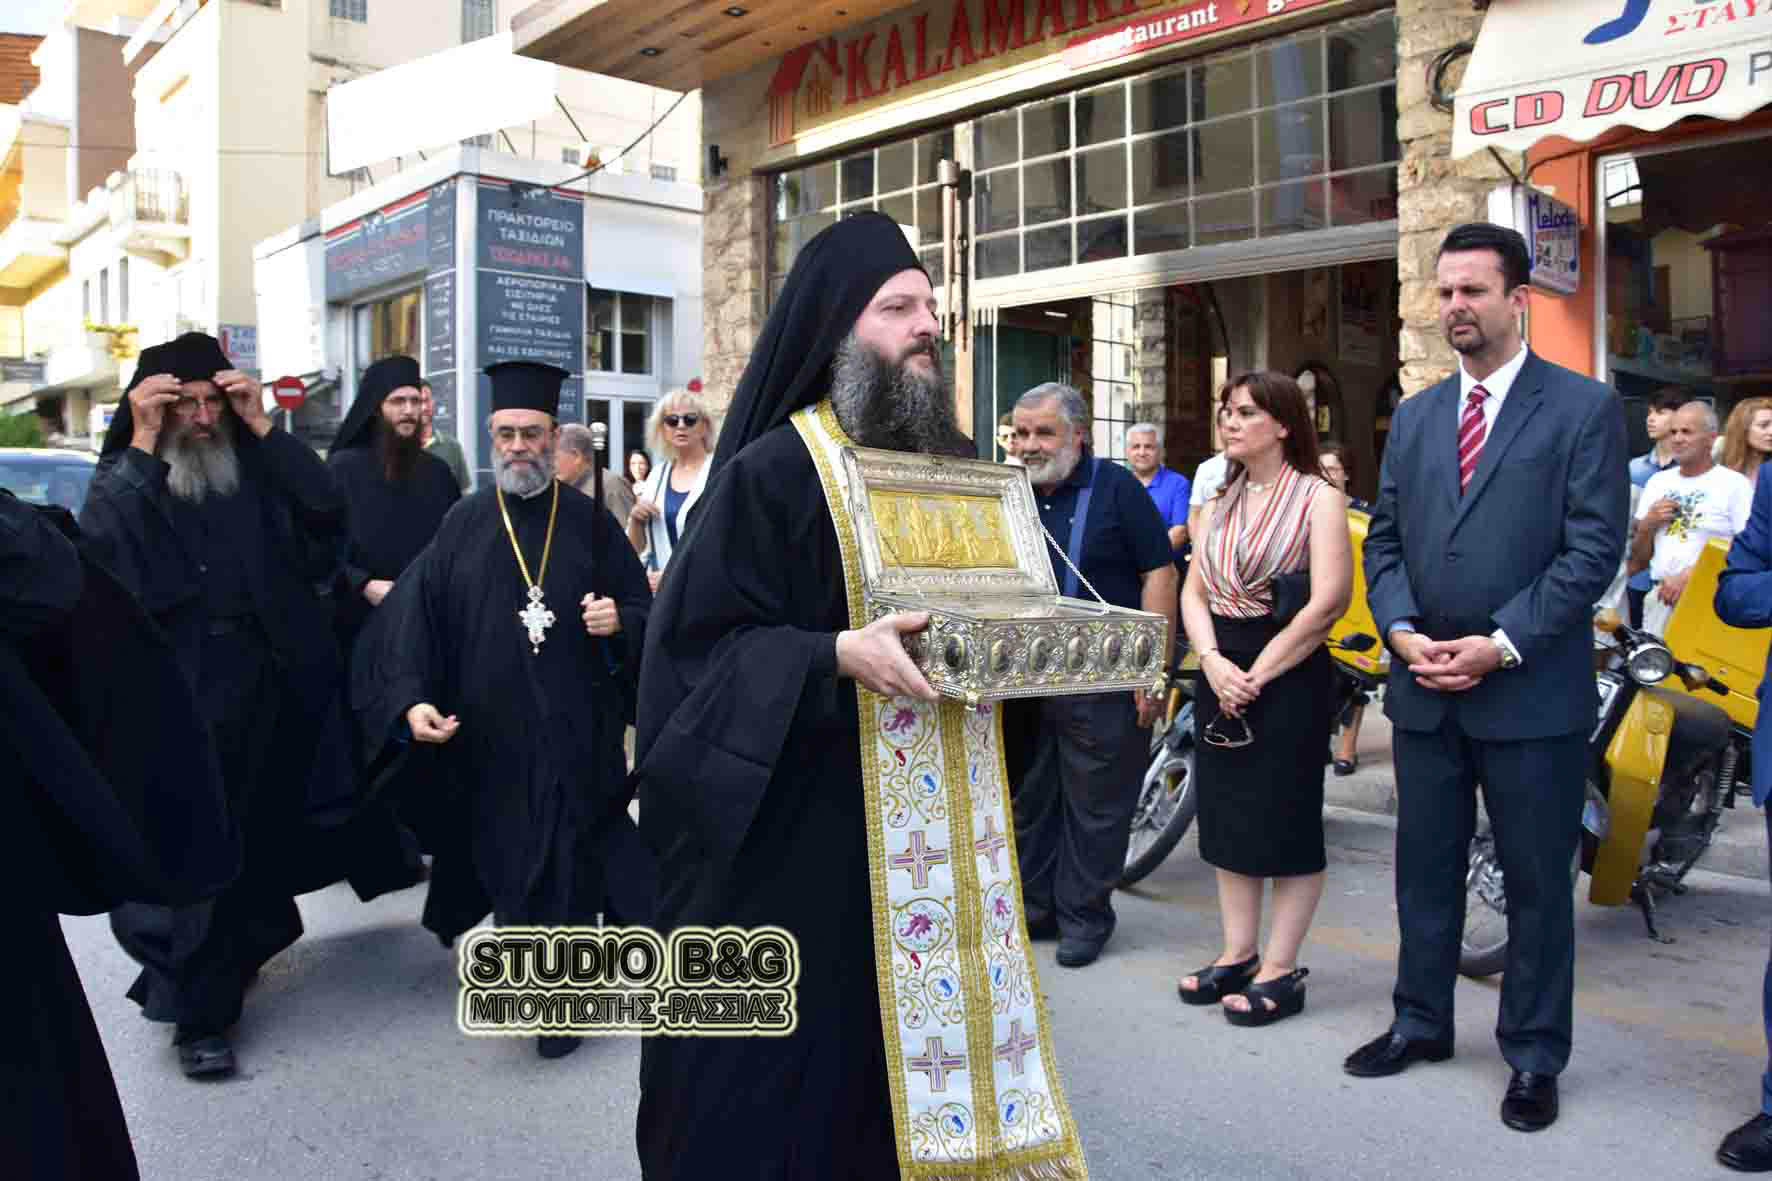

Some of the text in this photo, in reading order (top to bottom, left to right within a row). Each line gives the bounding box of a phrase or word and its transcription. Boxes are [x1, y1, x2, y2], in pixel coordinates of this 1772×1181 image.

[1088, 4, 1218, 53] taurant
[1664, 0, 1772, 35] ΣΤΑΥ
[1470, 90, 1565, 136] CD
[1582, 57, 1728, 119] DVD
[487, 208, 576, 233] ΠΡΑΚΤΟΡΕΙΟ
[499, 227, 566, 248] ΤΑΞΙΔΙΩΝ
